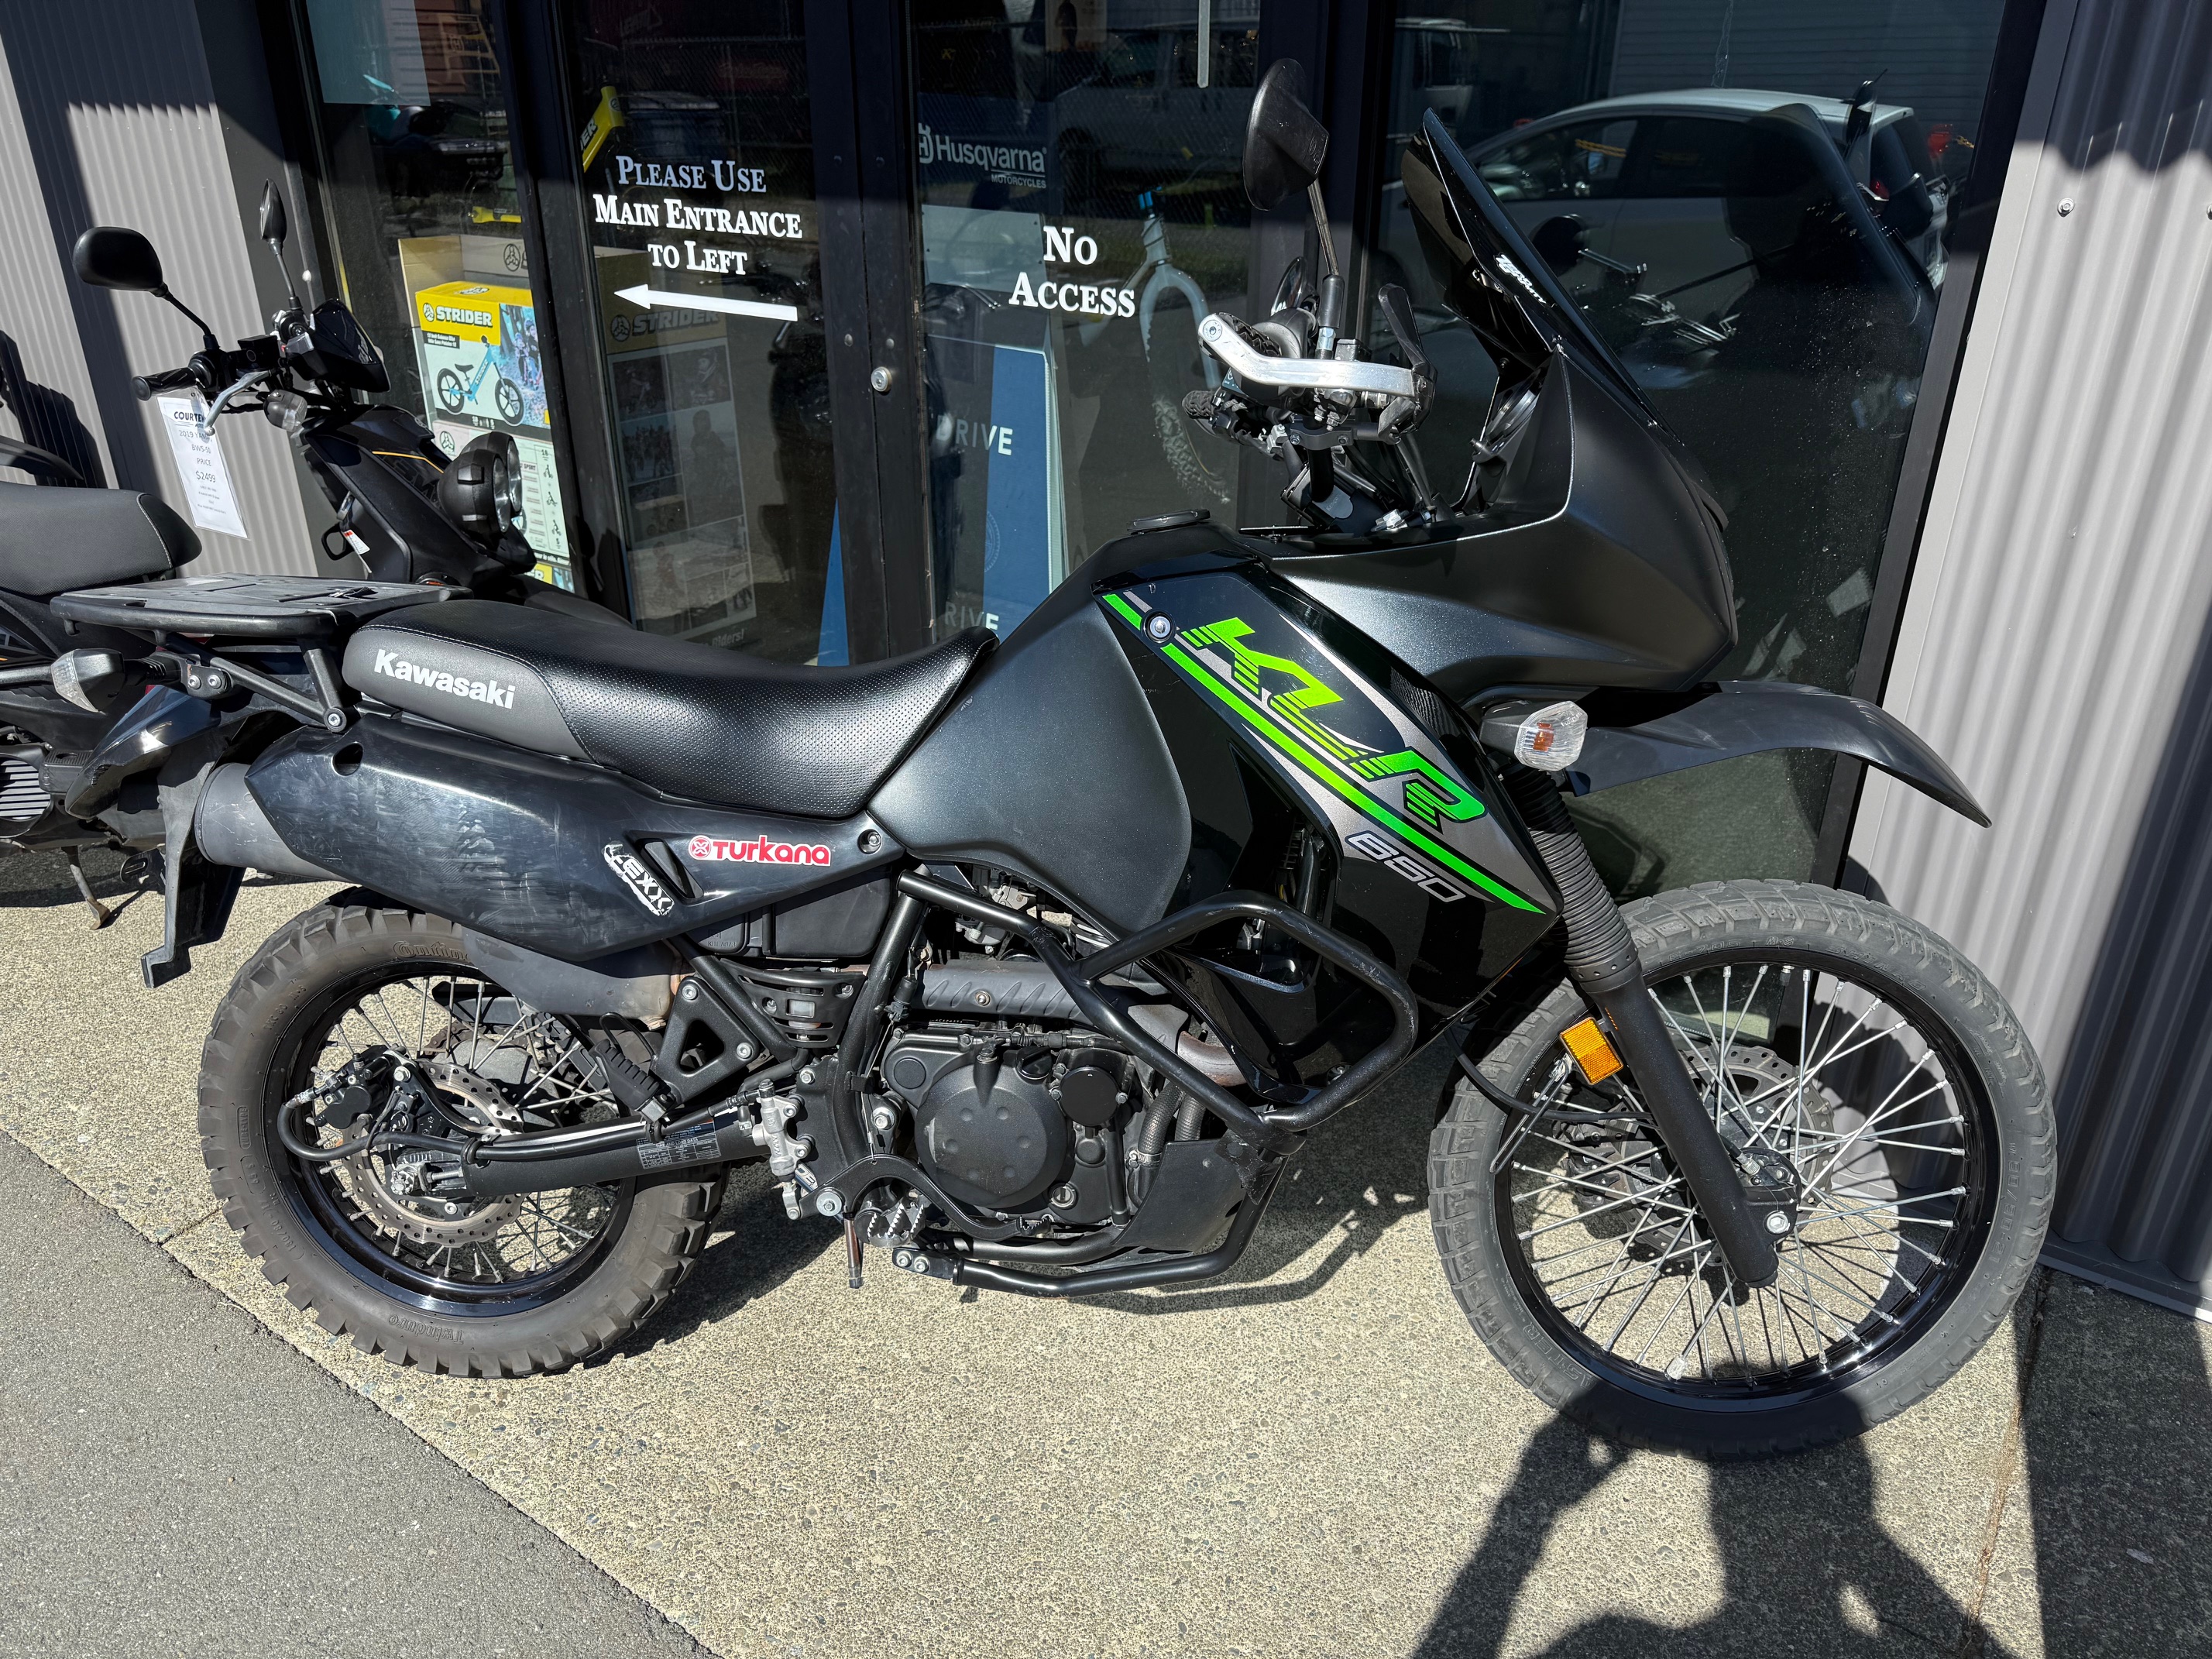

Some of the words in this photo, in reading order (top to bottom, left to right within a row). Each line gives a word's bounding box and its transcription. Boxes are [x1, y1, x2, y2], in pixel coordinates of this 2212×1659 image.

[936, 135, 1045, 173] Husqvarna
[616, 156, 707, 189] PLEASE
[711, 160, 767, 193] USE
[991, 173, 1046, 189] MOTORCYCLES
[592, 194, 659, 227] MAIN
[664, 198, 802, 239] ENTRANCE
[647, 244, 680, 270] TO
[684, 240, 748, 275] LEFT
[1043, 225, 1098, 265] NO
[1008, 272, 1135, 318] ACCESS
[436, 305, 493, 328] STRIDER
[632, 309, 720, 336] STRIDER
[180, 430, 194, 438] 2019
[936, 414, 1013, 455] DRIVE
[195, 470, 216, 483] $2499
[197, 458, 211, 466] PRICE
[374, 649, 516, 709] Kawasaki
[1181, 617, 1486, 827] KLR
[713, 836, 830, 864] Turkana
[1348, 832, 1466, 902] 650
[1826, 944, 1927, 991] SHINKO
[389, 1314, 463, 1345] Twinduro
